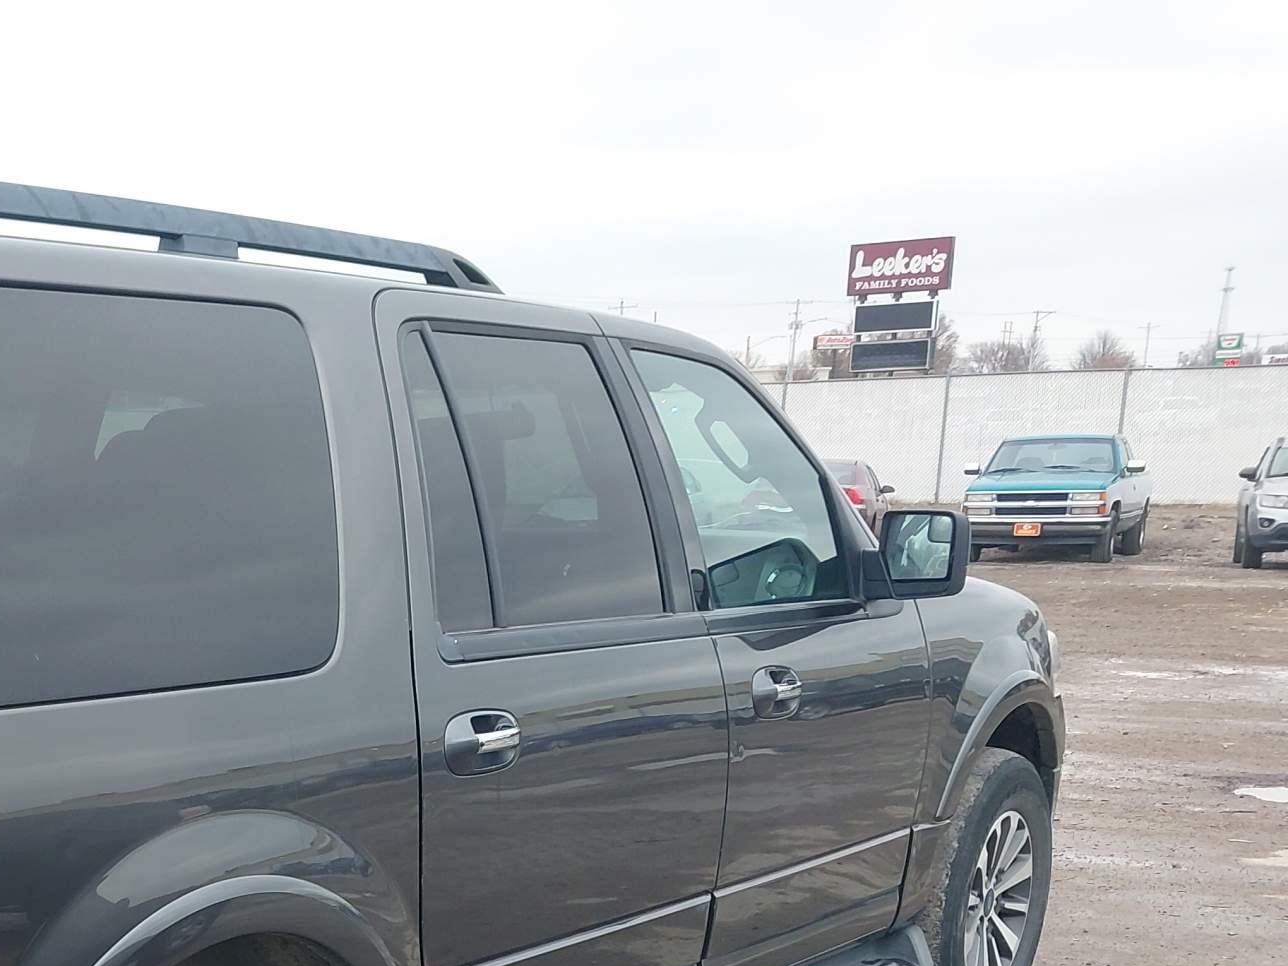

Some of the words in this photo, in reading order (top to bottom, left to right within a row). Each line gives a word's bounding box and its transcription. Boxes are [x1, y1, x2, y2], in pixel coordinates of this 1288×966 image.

[851, 247, 948, 279] Leeker's
[854, 277, 899, 291] FAMILY
[900, 275, 940, 288] FOODS
